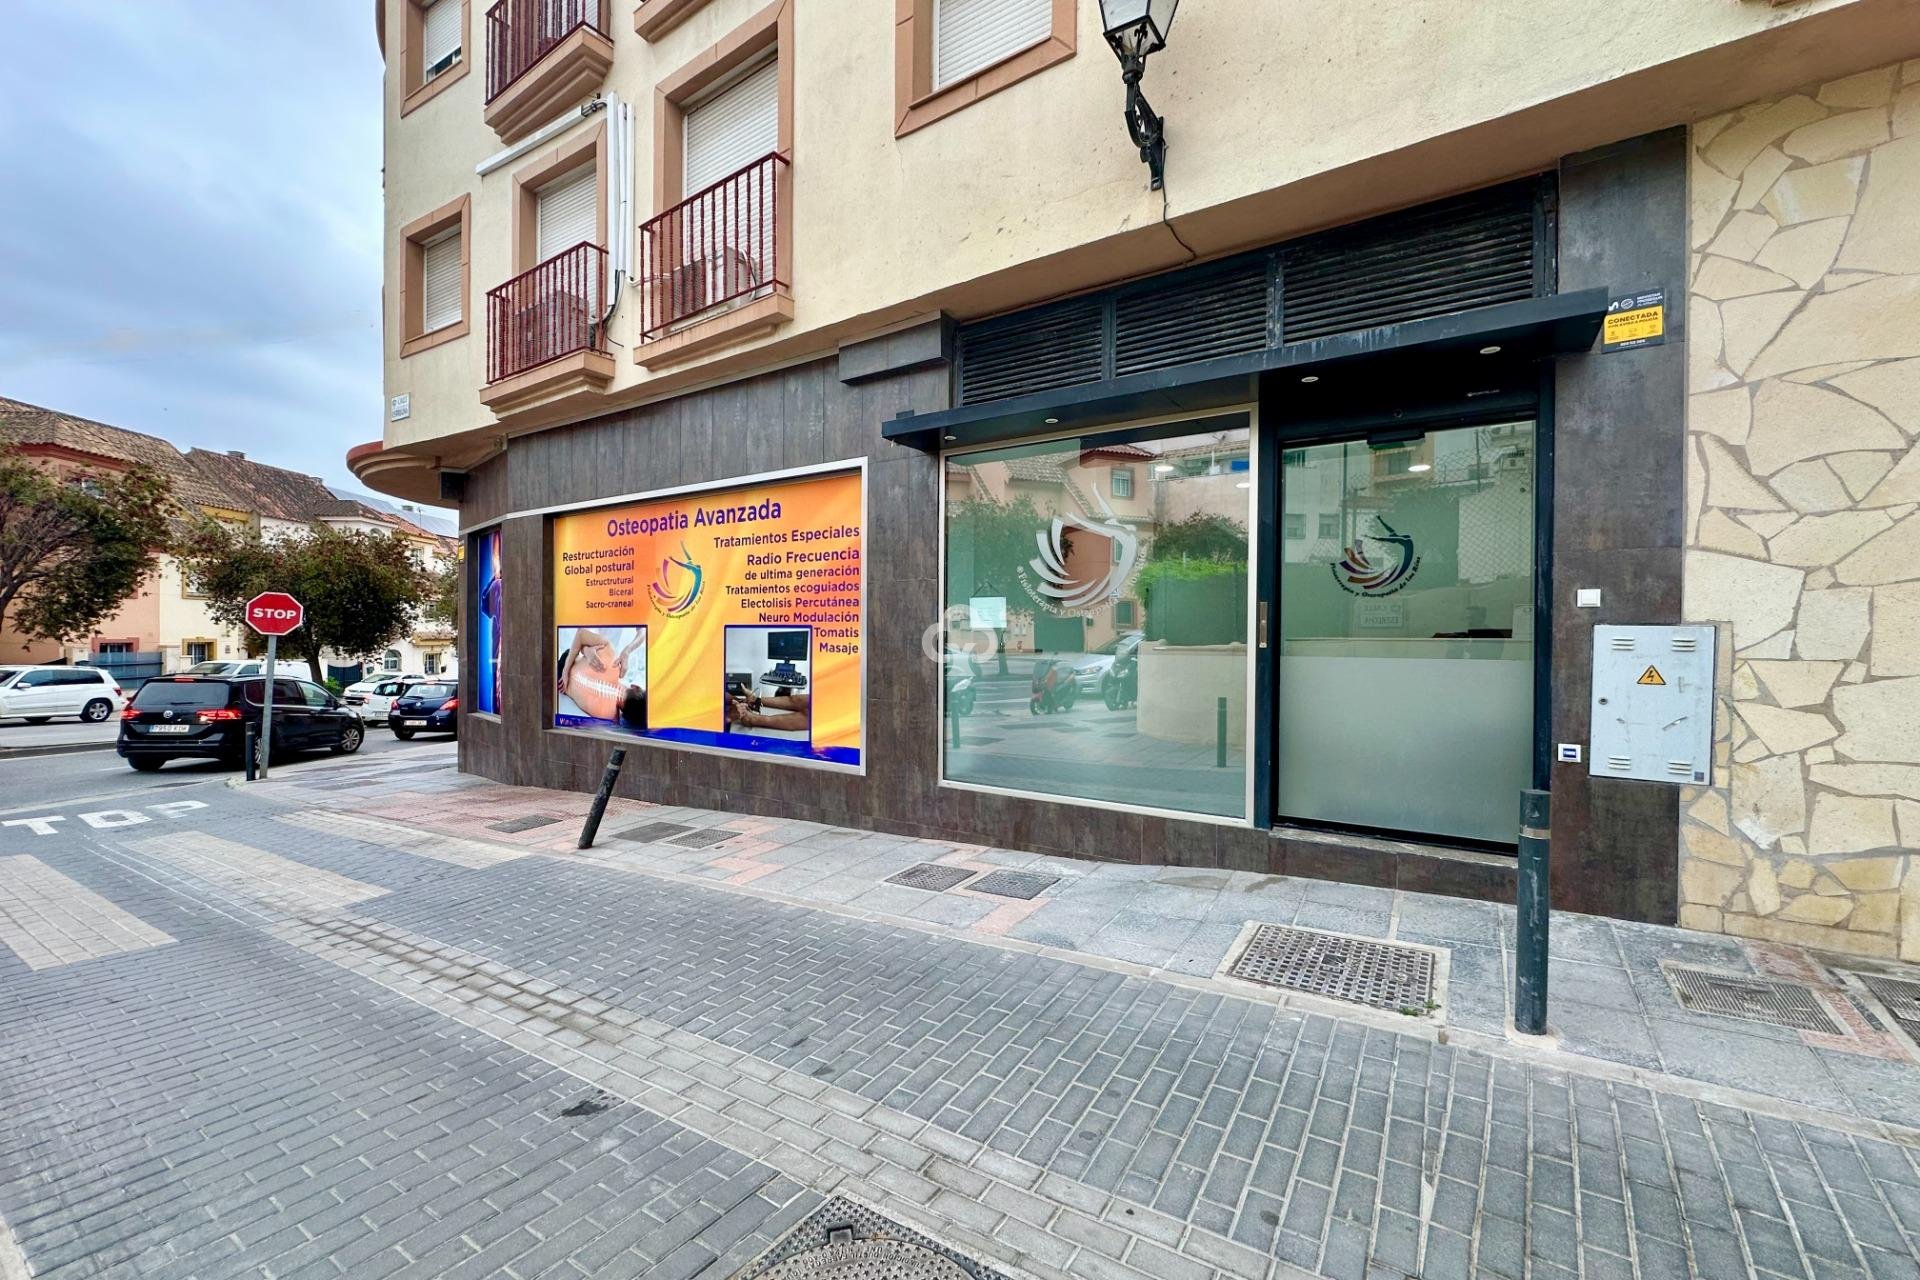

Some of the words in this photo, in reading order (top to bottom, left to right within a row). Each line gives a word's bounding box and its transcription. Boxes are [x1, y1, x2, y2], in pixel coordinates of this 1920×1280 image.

[1607, 311, 1659, 325] CONECTADA
[607, 510, 689, 538] Osteopatia
[694, 498, 782, 527] Avanzada
[714, 531, 788, 548] Tratamientos
[791, 525, 860, 543] Especiales
[562, 546, 635, 562] Restructuración
[747, 553, 782, 566] Radio
[786, 547, 860, 563] Frecuencia
[564, 564, 593, 575] Global
[595, 560, 635, 575] postural
[745, 571, 757, 581] de
[796, 564, 860, 580] generación
[608, 587, 634, 597] Biceral
[726, 583, 790, 595] Tratamientos
[793, 580, 860, 594] ecoguiados
[586, 599, 634, 609] Sacro-craneal
[741, 597, 792, 609] Electolisis
[795, 595, 860, 609] Percutánea
[252, 607, 297, 620] STOP
[759, 612, 790, 623] Neuro
[793, 611, 860, 623] Modulación
[814, 626, 860, 638] Tomatis
[819, 642, 860, 655] Masaje
